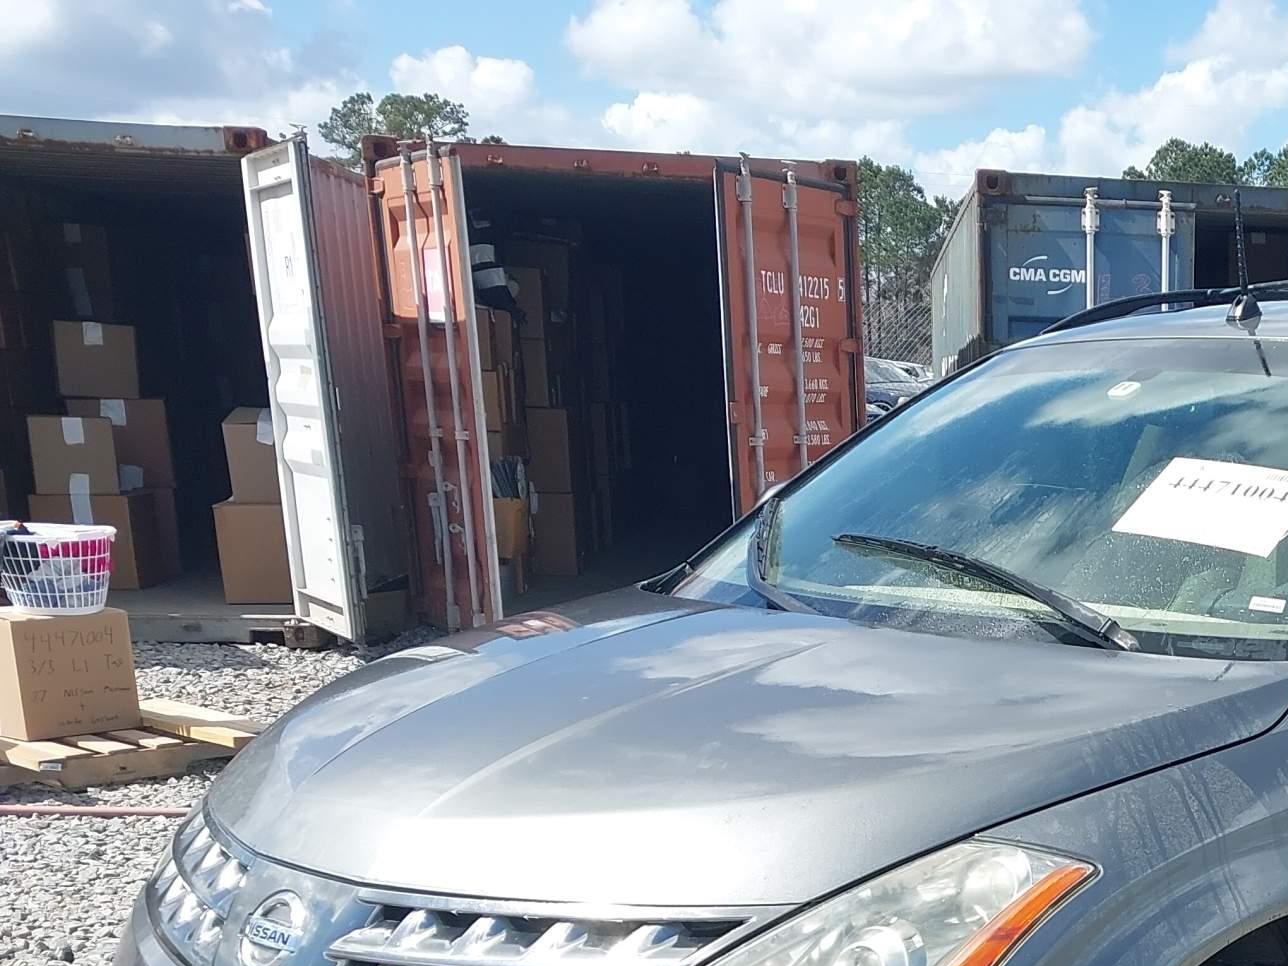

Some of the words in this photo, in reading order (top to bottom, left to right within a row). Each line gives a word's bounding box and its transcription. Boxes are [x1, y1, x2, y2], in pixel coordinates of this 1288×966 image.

[761, 270, 785, 294] TCLU
[1009, 267, 1046, 282] CMA
[1050, 269, 1086, 283] CGM
[24, 624, 113, 653] 44471004
